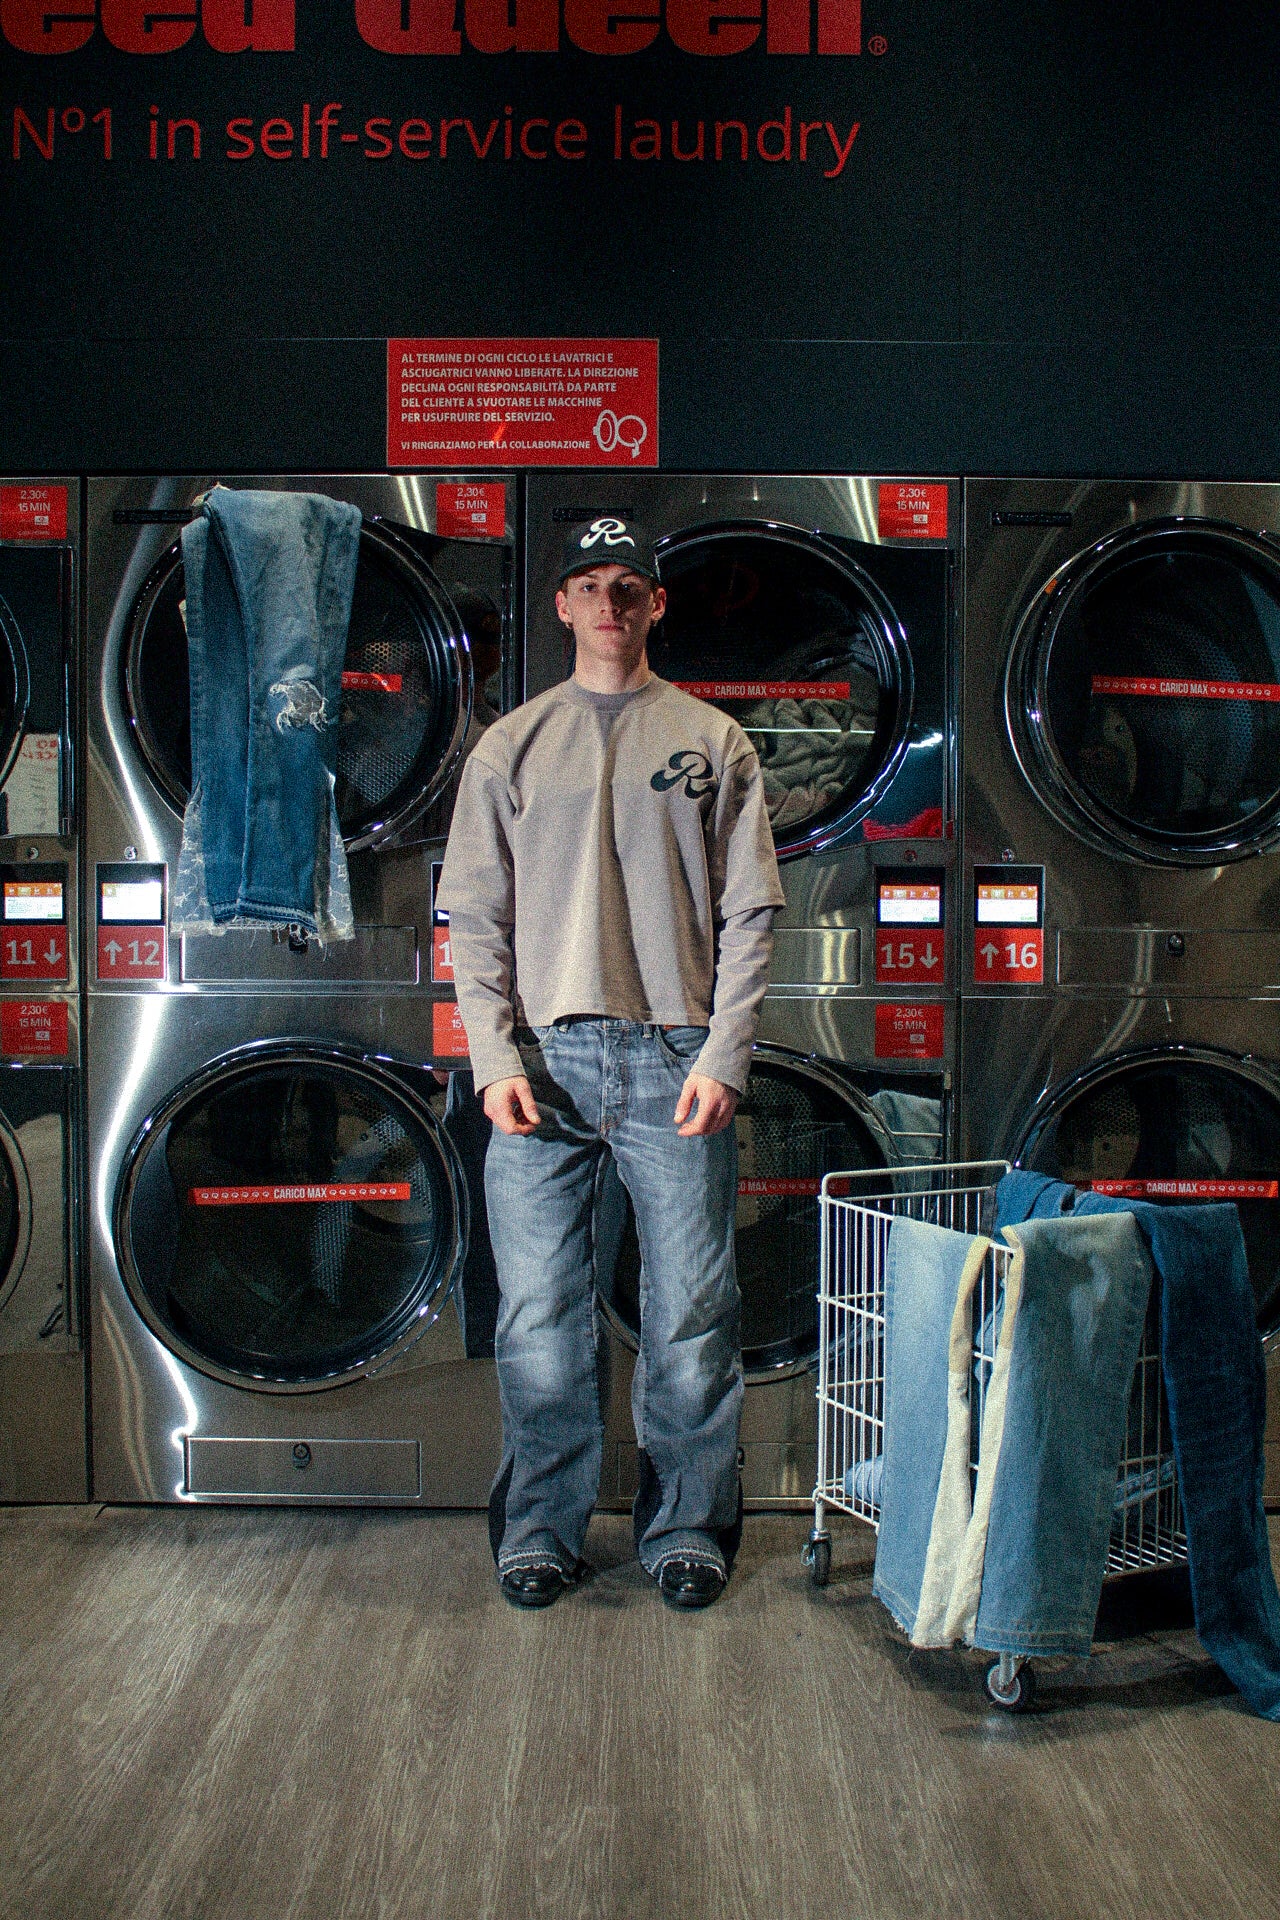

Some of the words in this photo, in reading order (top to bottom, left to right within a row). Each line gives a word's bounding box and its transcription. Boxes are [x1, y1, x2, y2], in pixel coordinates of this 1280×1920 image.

[149, 105, 202, 160] in
[226, 103, 588, 160] self-service
[614, 105, 861, 178] laundry
[401, 353, 415, 363] AL
[416, 353, 462, 363] TERMINE
[464, 353, 476, 363] DI
[477, 353, 505, 363] OGNI
[506, 353, 537, 363] CICLO
[539, 353, 551, 363] LE
[553, 353, 605, 363] LAVATRICI
[607, 353, 614, 363] E
[401, 367, 473, 378] ASCIUGATRICI
[474, 367, 513, 378] VANNO
[514, 367, 566, 378] LIBERATE.
[567, 367, 581, 378] LA
[583, 367, 639, 378] DIREZIONE
[401, 382, 446, 393] DECLINA
[447, 382, 475, 393] OGNI
[477, 380, 565, 393] RESPONSABILITÀ
[566, 382, 582, 392] DA
[583, 382, 617, 392] PARTE
[401, 397, 421, 408] DEL
[422, 397, 465, 408] CLIENTE
[467, 397, 475, 407] A
[476, 397, 532, 407] SVUOTARE
[533, 397, 546, 407] LE
[547, 397, 602, 407] MACCHINE
[401, 412, 421, 423] PER
[422, 412, 481, 422] USUFRUIRE
[482, 412, 503, 422] DEL
[504, 411, 555, 422] SERVIZIO.
[401, 441, 411, 450] VI
[411, 440, 477, 450] RINGRAZIAMO
[477, 440, 495, 449] PER
[496, 440, 508, 449] LA
[509, 440, 591, 450] COLLABORAZIONE
[18, 502, 28, 512] 15
[29, 502, 51, 512] MIN
[455, 500, 465, 510] 15
[466, 500, 488, 510] MIN
[896, 501, 907, 511] 15
[908, 501, 930, 511] MIN
[715, 685, 745, 696] CARICO
[747, 685, 767, 696] MAX
[1160, 682, 1188, 694] CARICO
[1190, 683, 1208, 695] MAX
[6, 939, 37, 966] 11
[127, 939, 160, 967] 12
[880, 942, 915, 969] 15
[1004, 942, 1038, 969] 16
[19, 1018, 29, 1028] 15
[30, 1018, 51, 1027] MIN
[451, 1019, 462, 1029] 15
[893, 1021, 904, 1031] 15
[905, 1020, 927, 1031] MIN
[747, 1181, 767, 1192] MAX
[1146, 1182, 1177, 1194] CARICO
[1178, 1182, 1197, 1194] MAX
[274, 1188, 305, 1199] CARICO
[307, 1187, 327, 1198] MAX
